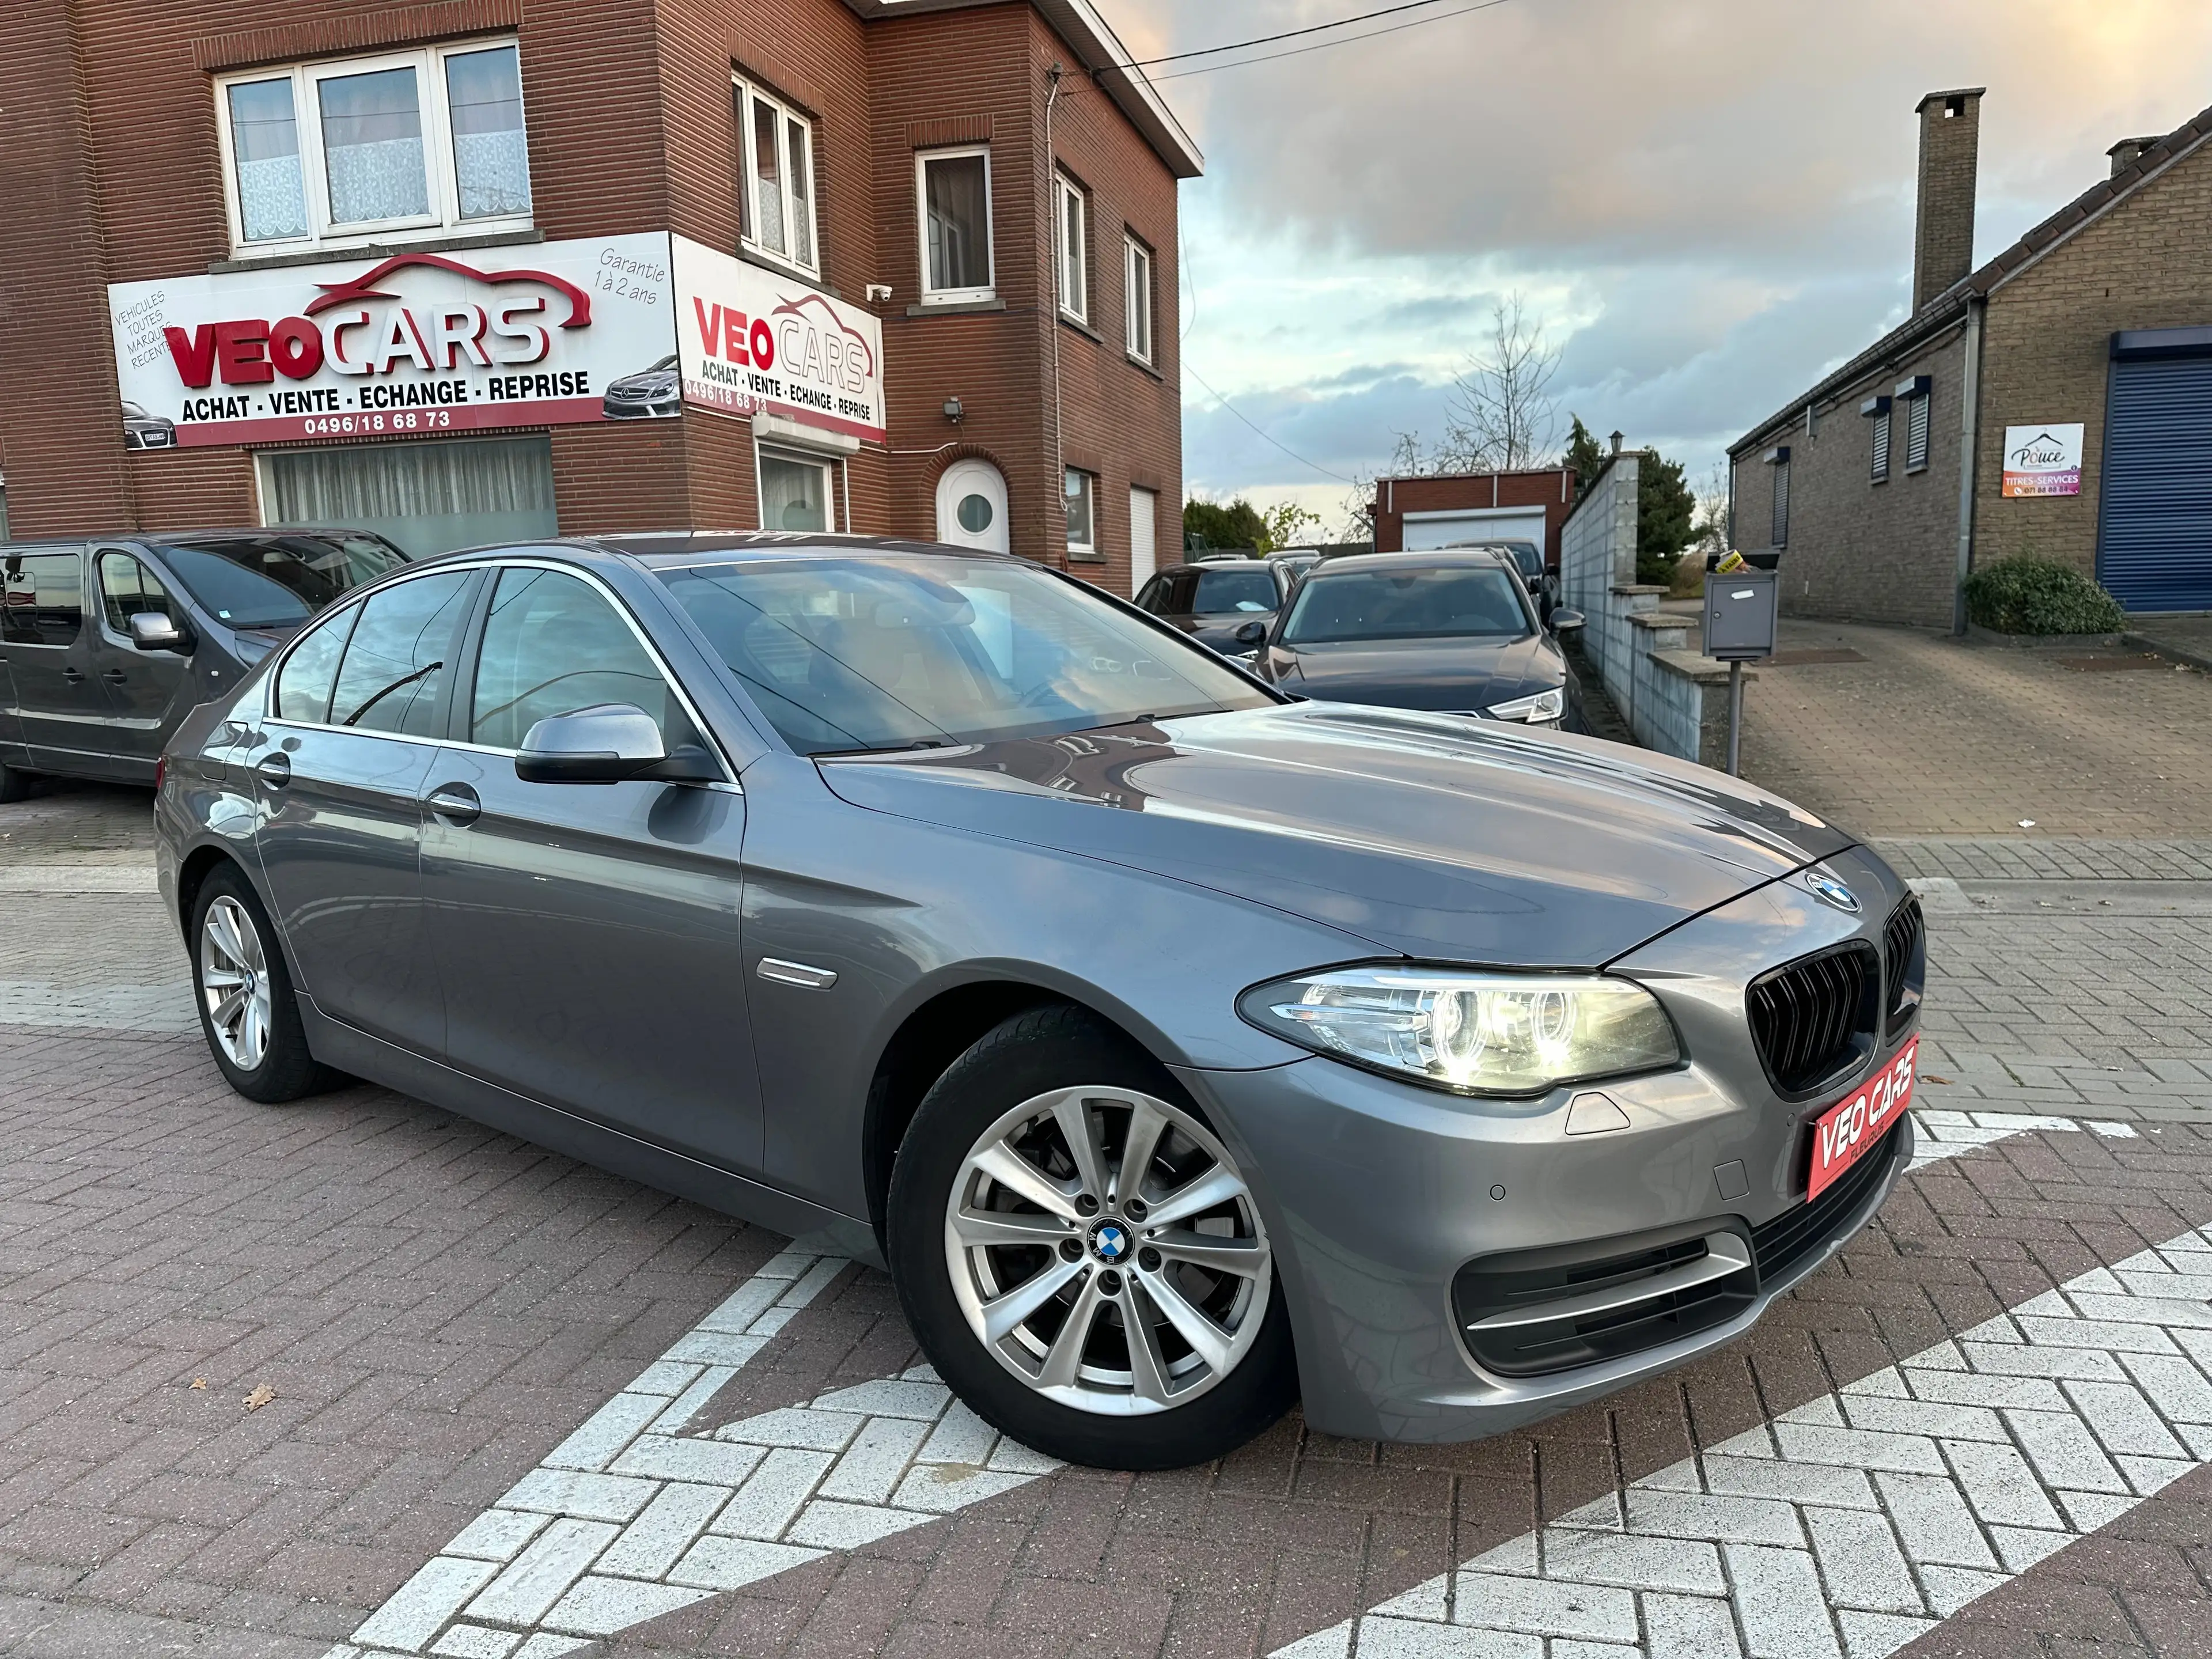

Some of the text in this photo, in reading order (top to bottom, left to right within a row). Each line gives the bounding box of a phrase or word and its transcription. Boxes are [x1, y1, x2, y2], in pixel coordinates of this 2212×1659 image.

[600, 248, 665, 282] Garantie
[594, 270, 657, 305] 1 à 2 ans
[115, 290, 165, 325] VEHICULES
[127, 309, 162, 336] TOUTES
[182, 371, 590, 421] ACHAT VENTE ECHANGE REPRISE
[684, 378, 767, 411] 0496/18 68 73
[702, 360, 870, 421] ACHAT VENTE ECHANGE REPRISE
[305, 411, 450, 434] 0496/18 68 73
[2011, 449, 2065, 467] Pouce
[2005, 475, 2078, 486] TITRES-SERVICES
[1822, 1046, 1915, 1169] VEO CARS
[1850, 1120, 1884, 1163] FLEURUS
